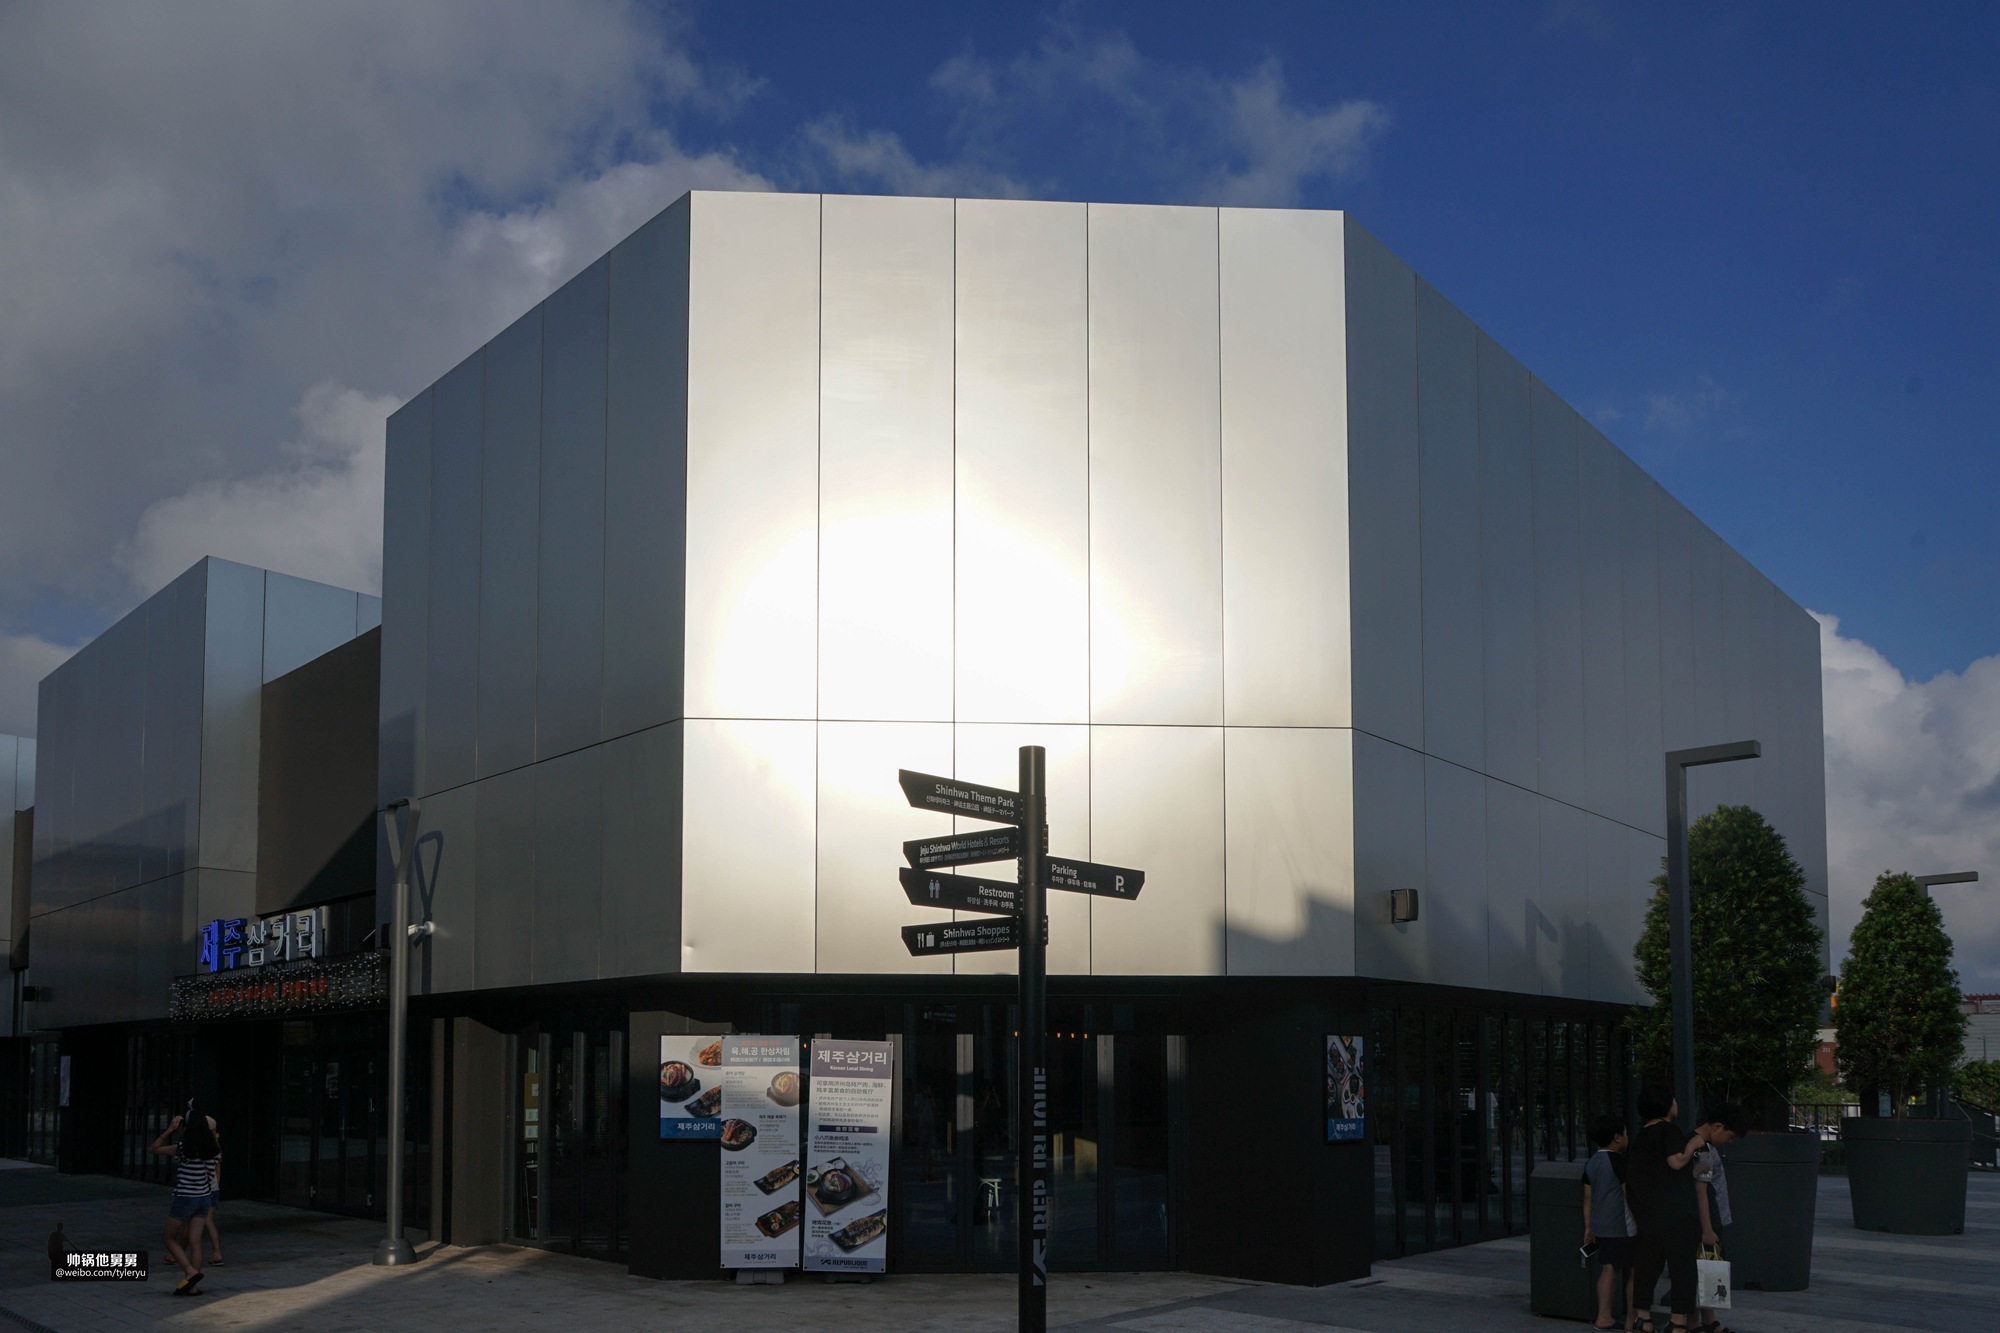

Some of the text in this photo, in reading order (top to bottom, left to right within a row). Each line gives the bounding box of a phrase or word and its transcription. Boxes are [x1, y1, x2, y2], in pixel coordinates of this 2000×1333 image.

[936, 784, 1014, 808] Shinhwa Theme Park
[920, 846, 930, 856] Jeju
[930, 843, 951, 853] Shinhwa
[951, 840, 966, 850] World
[967, 839, 983, 848] Hotels
[989, 836, 1009, 846] Resorts
[1052, 864, 1077, 878] Parking
[978, 886, 1014, 899] Restroom
[944, 926, 1010, 938] Shinhwa Shoppes
[201, 908, 322, 972] 제주삼거리
[817, 1050, 887, 1065] 제주삼거리
[677, 1122, 715, 1130] 제주삼거리
